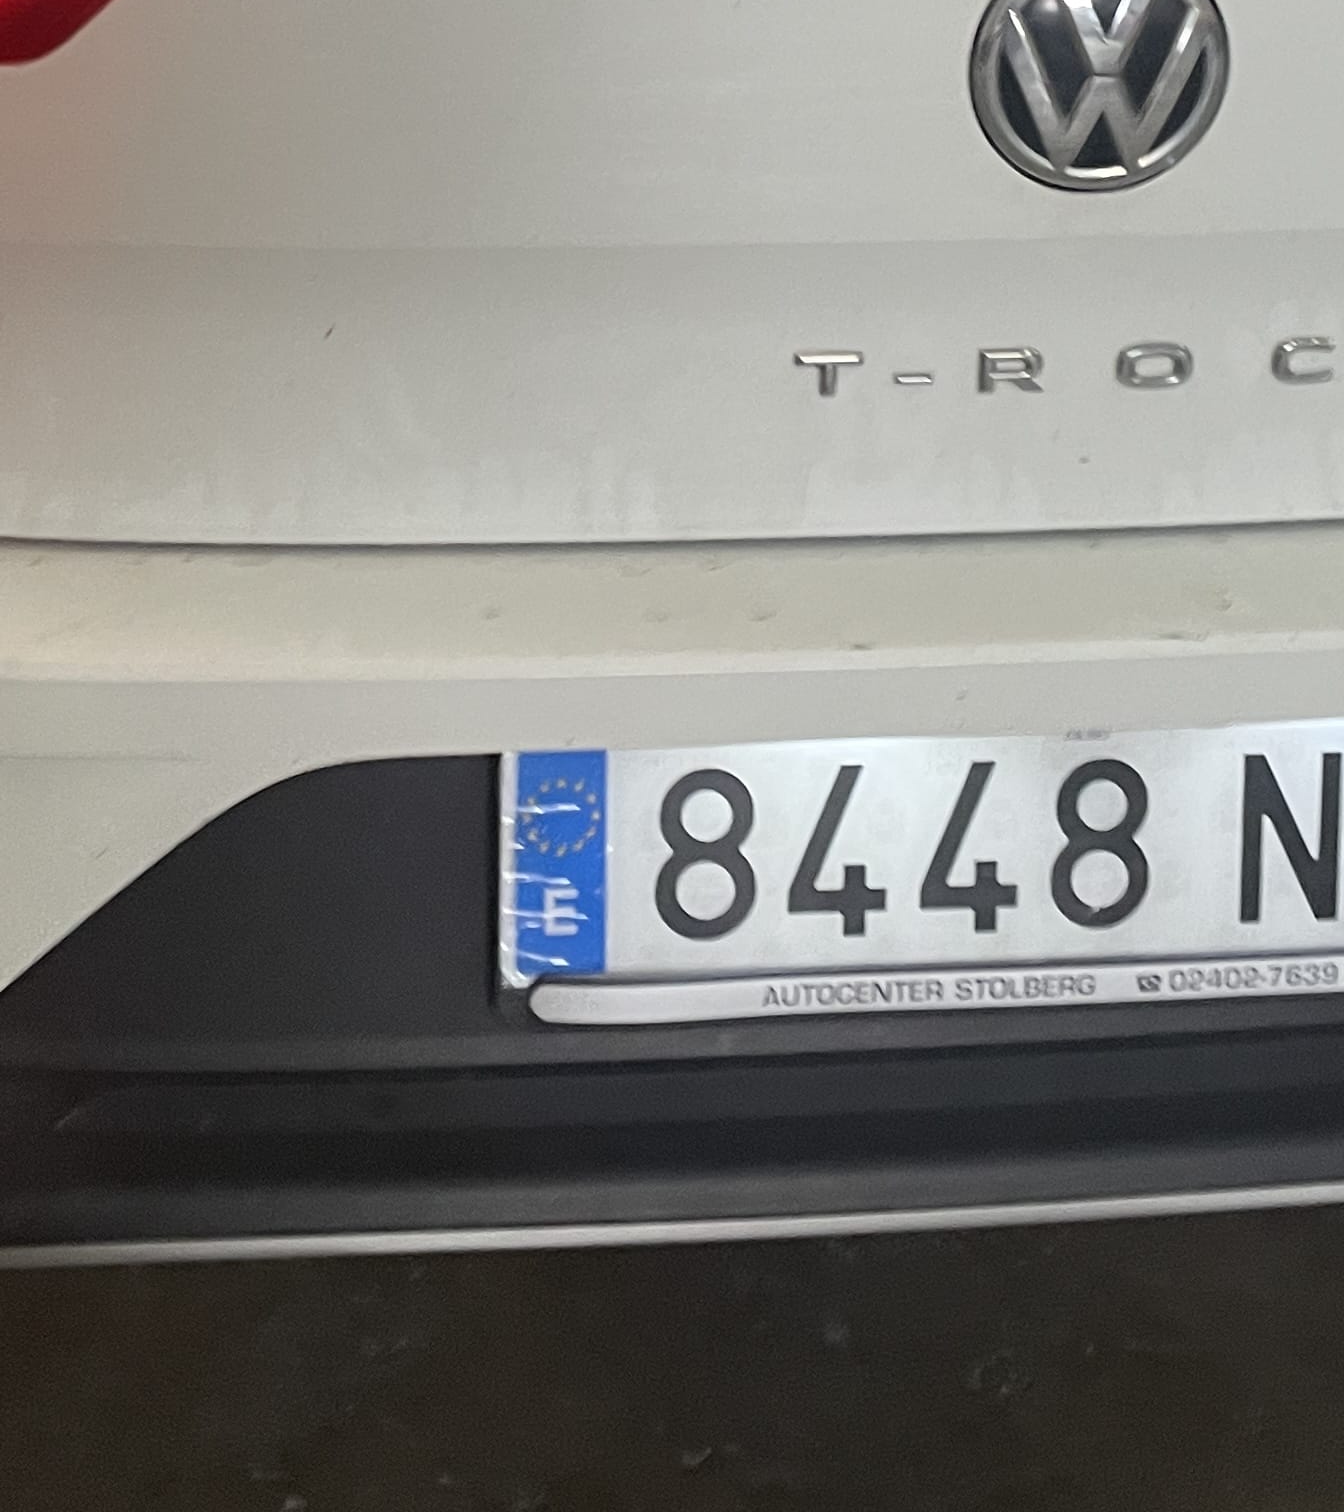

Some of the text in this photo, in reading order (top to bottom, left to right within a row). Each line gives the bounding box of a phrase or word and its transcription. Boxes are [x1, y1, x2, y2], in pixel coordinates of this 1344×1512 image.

[656, 757, 1150, 941] 8448
[544, 886, 580, 936] E
[762, 979, 945, 1008] AUTOCENTER
[955, 973, 1097, 1001] STOLBERG
